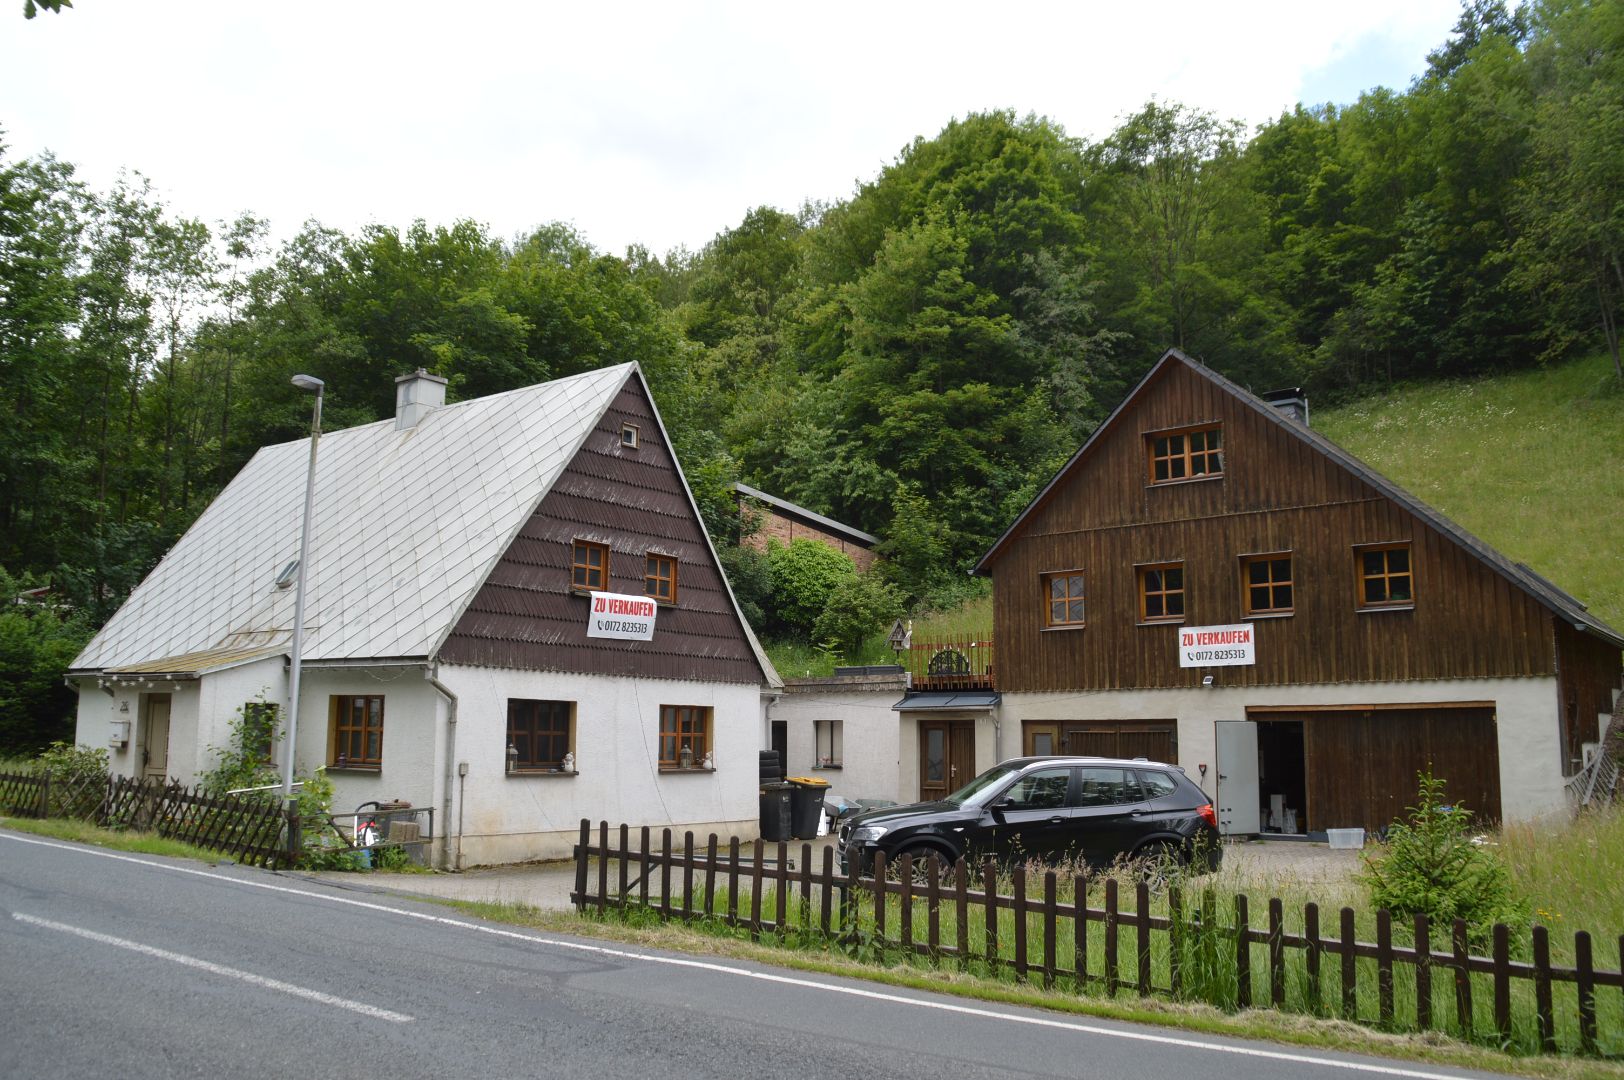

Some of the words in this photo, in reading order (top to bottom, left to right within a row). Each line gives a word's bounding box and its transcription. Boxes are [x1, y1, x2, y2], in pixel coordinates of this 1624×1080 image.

[594, 598, 606, 612] ZU
[609, 599, 654, 617] VERKAUFEN
[605, 621, 620, 632] 0172
[622, 622, 647, 633] 8235313
[1182, 634, 1194, 646] ZU
[1196, 630, 1250, 645] VERKAUFEN
[1196, 652, 1212, 660] 0172
[1214, 650, 1245, 660] 8235313
